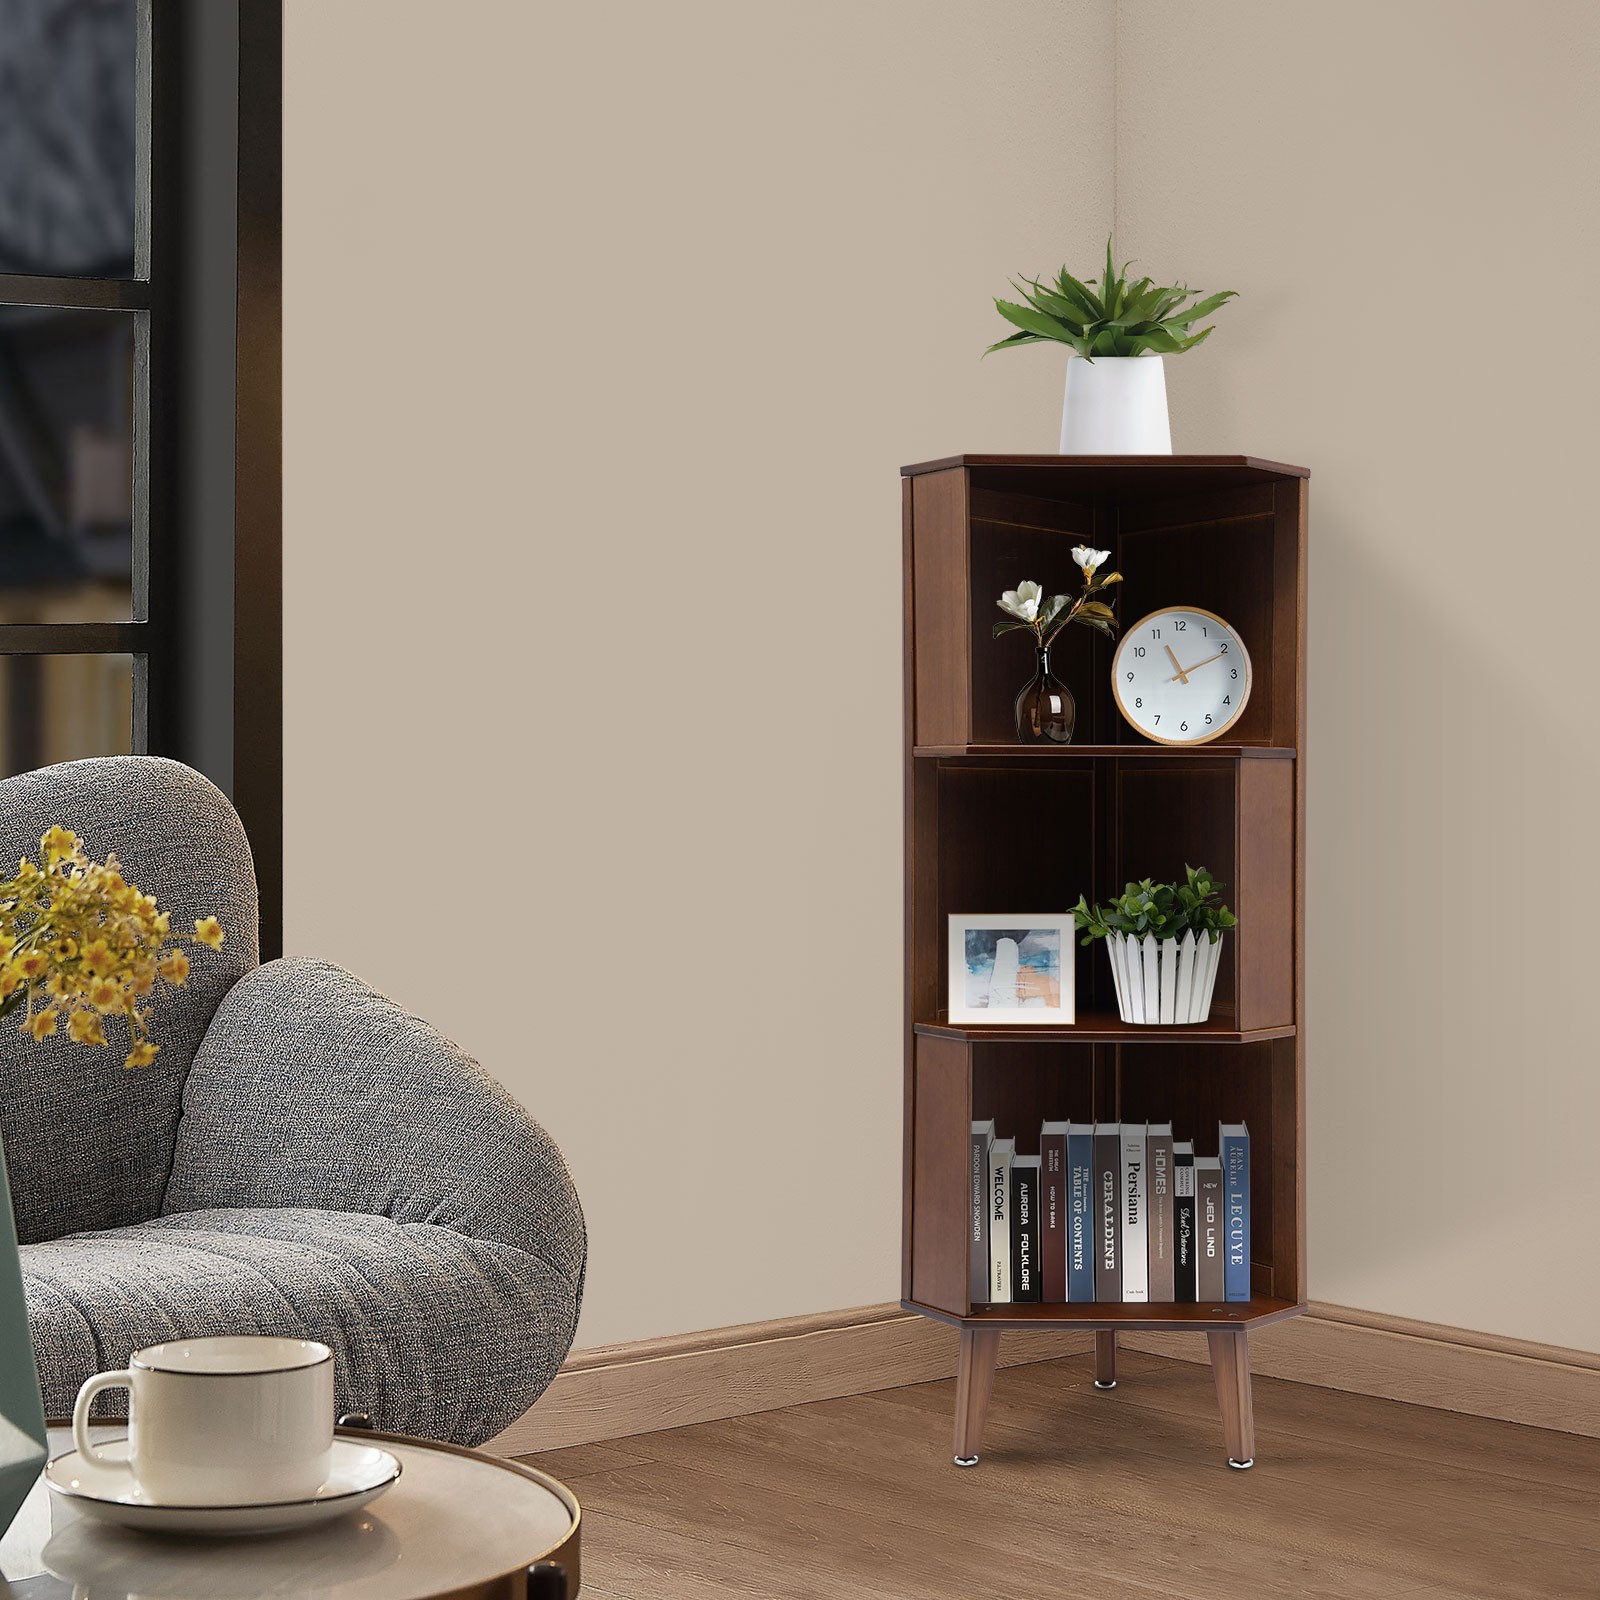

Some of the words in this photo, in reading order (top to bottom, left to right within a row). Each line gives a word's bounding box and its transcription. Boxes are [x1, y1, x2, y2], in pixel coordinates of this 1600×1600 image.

[1152, 630, 1161, 639] 11
[1174, 621, 1186, 631] 12
[1202, 628, 1207, 637] 1
[1134, 647, 1145, 657] 10
[1220, 643, 1228, 654] 2
[1127, 672, 1134, 682] 9
[1230, 669, 1237, 679] 3
[1135, 698, 1143, 708] 8
[1222, 695, 1231, 705] 4
[1154, 715, 1161, 725] 7
[1180, 721, 1188, 731] 6
[1205, 714, 1212, 724] 5
[973, 1145, 981, 1174] PARDON
[1229, 1145, 1237, 1187] AURELIE
[1236, 1146, 1244, 1171] JEAN
[1155, 1148, 1166, 1194] HOMES
[973, 1175, 981, 1204] EDWARD
[1073, 1166, 1082, 1197] TABLE
[994, 1166, 1004, 1221] WELCOME
[1127, 1162, 1141, 1225] Persiana
[1020, 1182, 1028, 1225] AURORA
[1050, 1202, 1056, 1210] TO
[1073, 1200, 1082, 1214] OF
[1206, 1197, 1215, 1223] JED
[1230, 1193, 1243, 1265] LECUYE
[1074, 1216, 1083, 1271] CONTENTS
[1206, 1228, 1215, 1257] LIND
[1021, 1233, 1030, 1291] FOLKLORE
